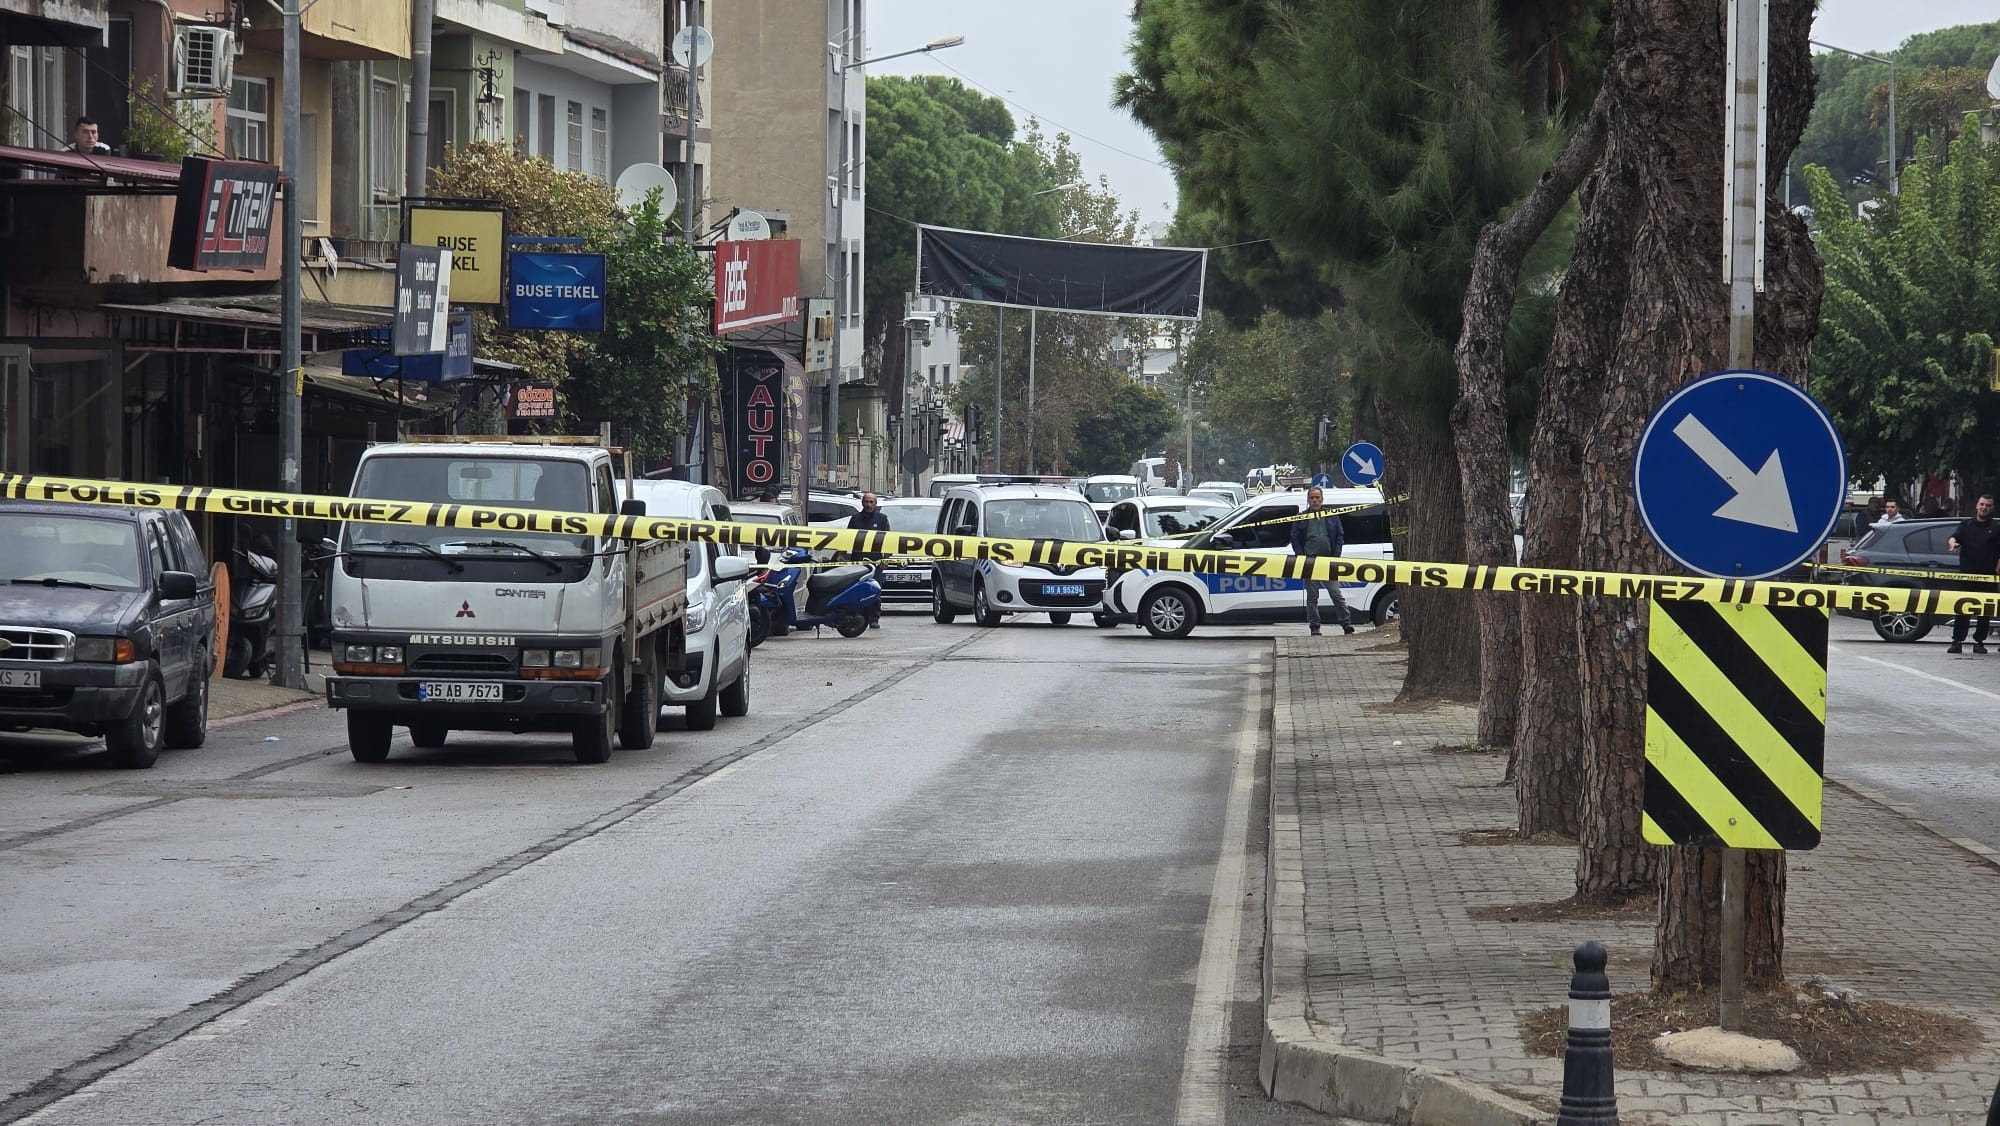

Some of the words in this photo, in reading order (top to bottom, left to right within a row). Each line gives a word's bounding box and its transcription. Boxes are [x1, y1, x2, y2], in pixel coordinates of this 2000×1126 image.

[451, 256, 479, 271] KEL
[516, 284, 553, 298] BUSE
[555, 285, 599, 299] TEKEL
[747, 385, 775, 482] AUTO
[495, 588, 546, 599] CANTER
[1046, 586, 1055, 594] 35
[409, 634, 516, 646] MITSUBISHI
[23, 672, 38, 686] 21
[427, 684, 442, 697] 35
[446, 684, 462, 697] AB
[468, 685, 500, 698] 7673
